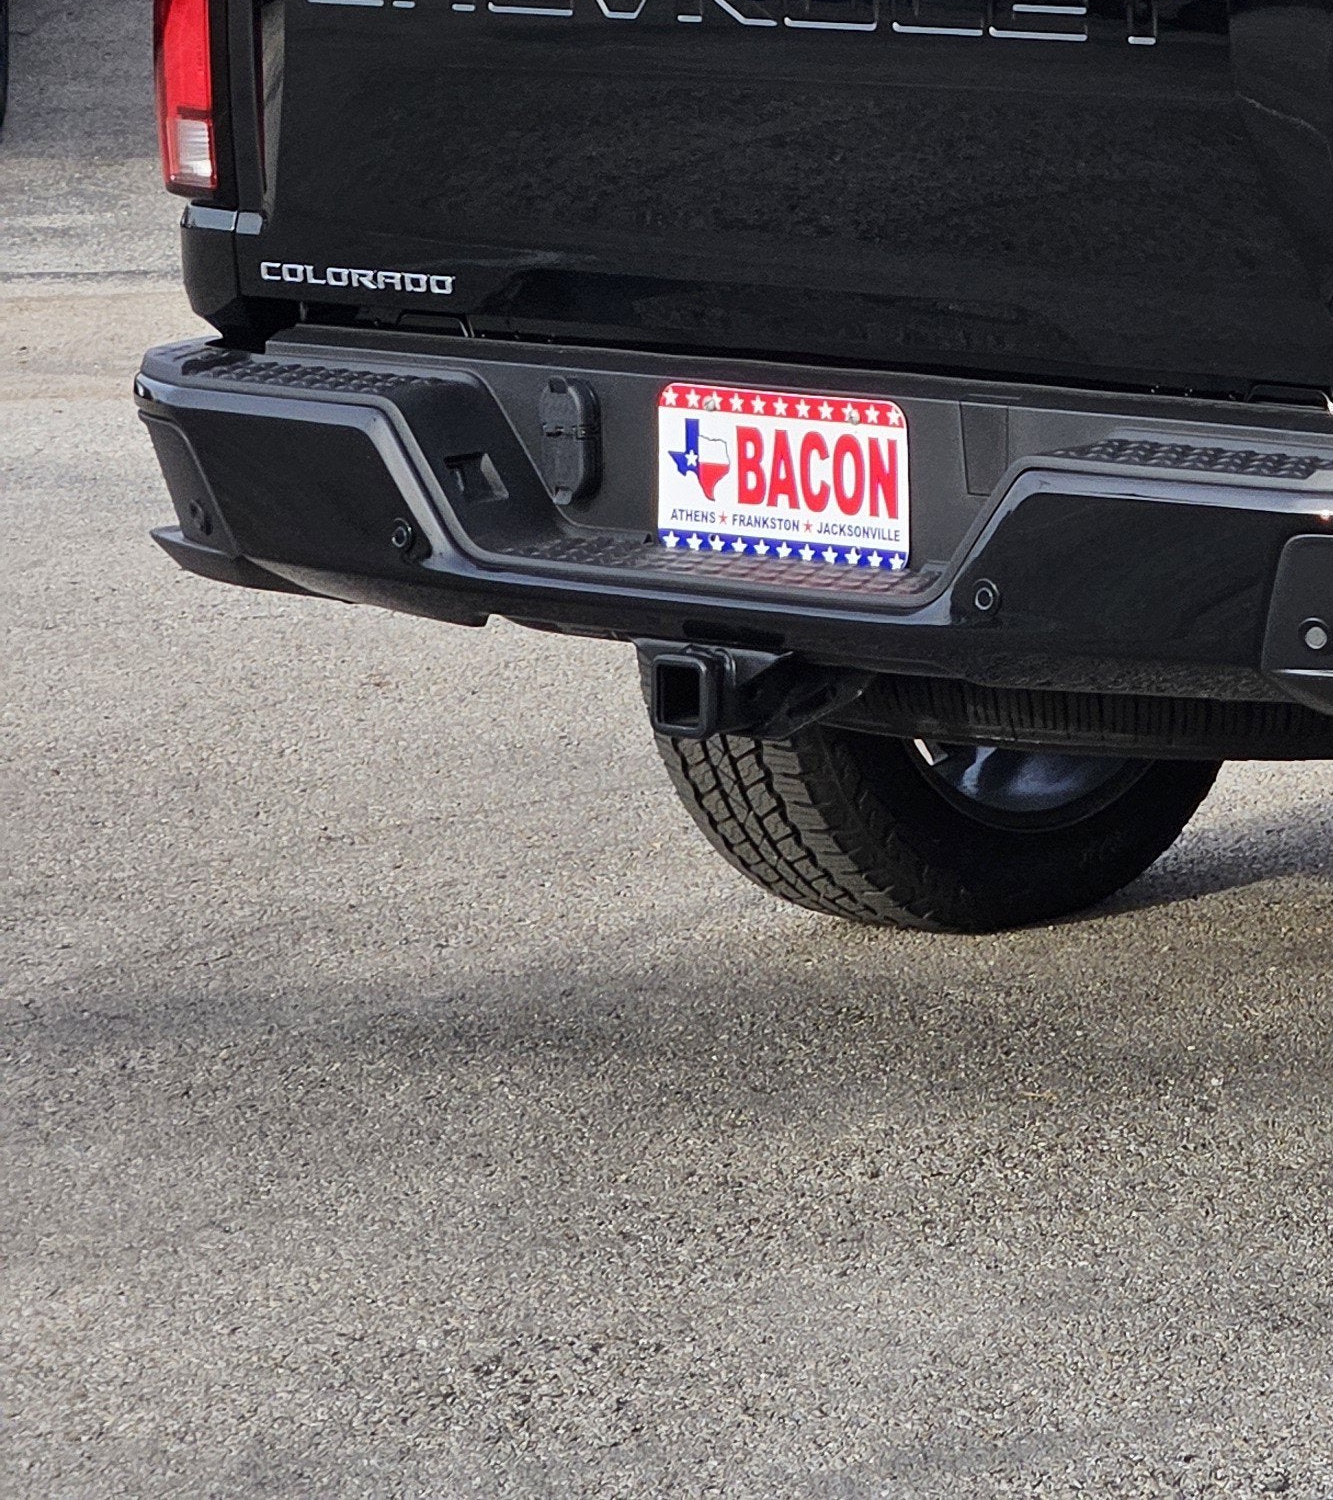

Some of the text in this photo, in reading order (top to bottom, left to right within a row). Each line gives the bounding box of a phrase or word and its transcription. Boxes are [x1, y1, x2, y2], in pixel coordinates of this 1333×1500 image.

[259, 260, 456, 295] COLORADO
[735, 425, 899, 520] BACON
[669, 507, 901, 543] ATHENS FRANKSTON JACKSONVILLE
